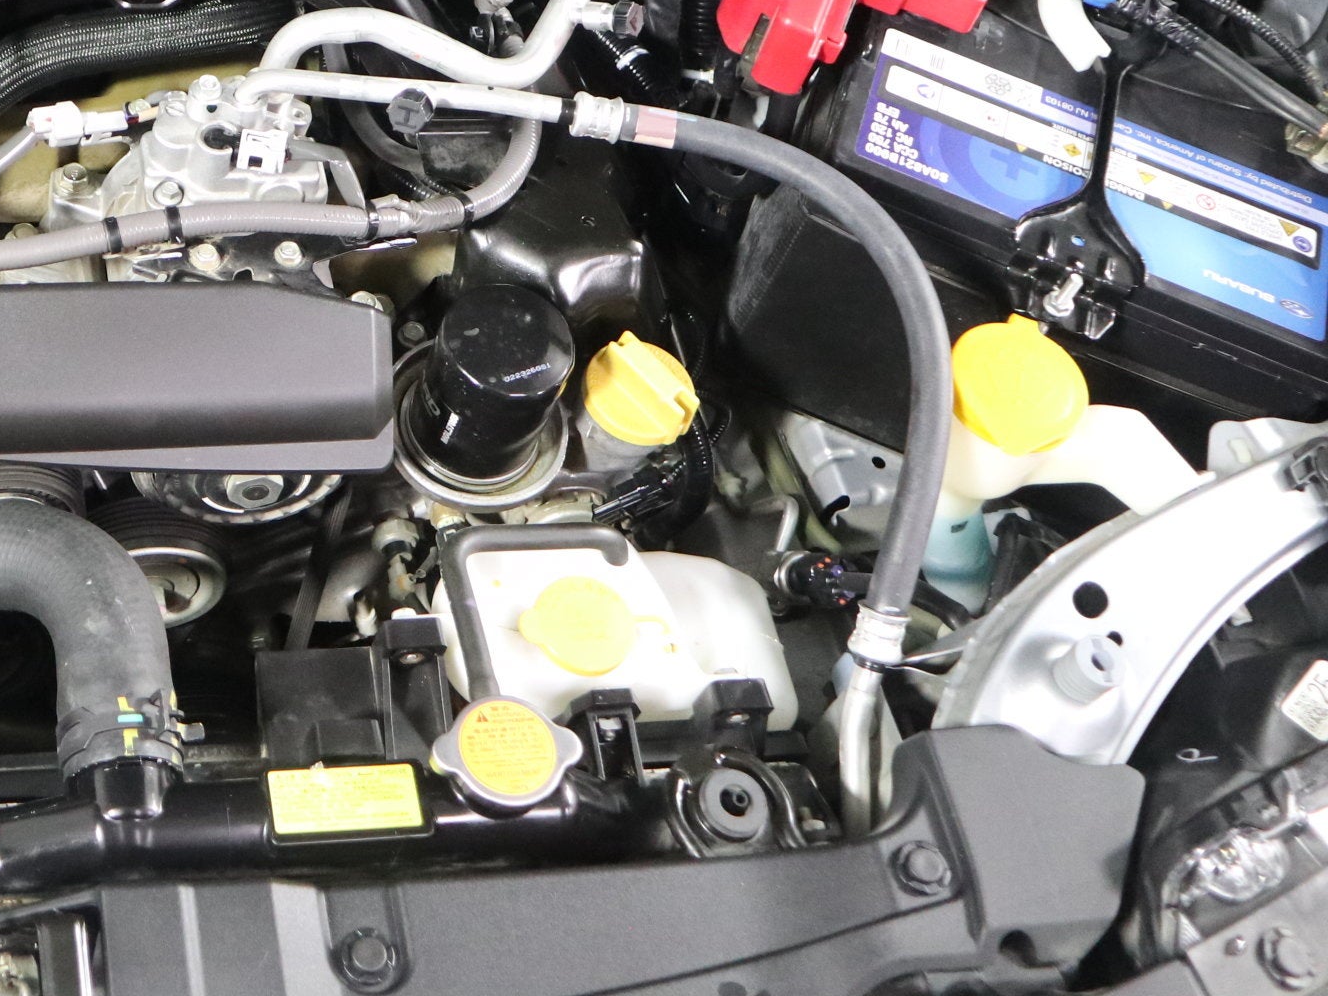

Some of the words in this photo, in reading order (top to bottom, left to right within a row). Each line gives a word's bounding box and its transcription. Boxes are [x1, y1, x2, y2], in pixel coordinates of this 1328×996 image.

[1074, 107, 1088, 117] NJ
[870, 121, 892, 138] 120
[890, 118, 909, 132] Ah
[894, 131, 914, 146] RC
[1133, 129, 1151, 142] Inc.
[892, 141, 919, 159] CCA
[1207, 157, 1242, 176] Subaru
[1258, 178, 1313, 203] Distributed
[1202, 268, 1275, 303] SUBARU
